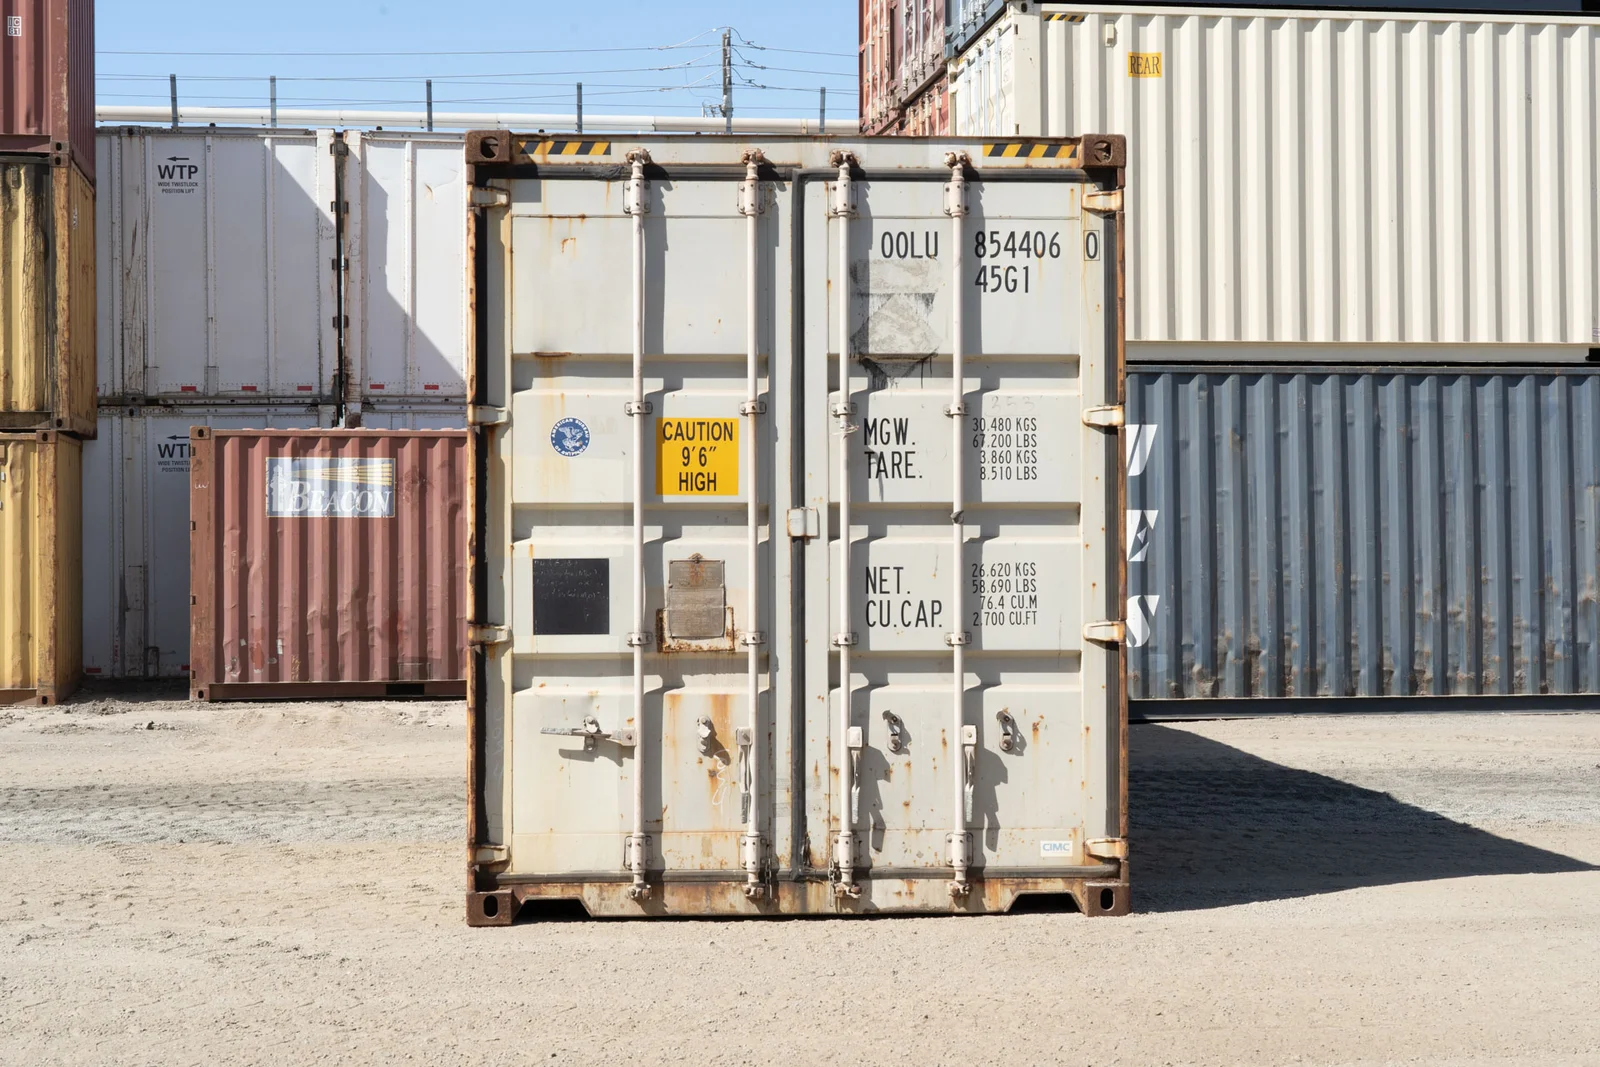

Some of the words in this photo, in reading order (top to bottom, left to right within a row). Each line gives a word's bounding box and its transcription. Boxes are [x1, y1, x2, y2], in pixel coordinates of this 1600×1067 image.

[1129, 56, 1160, 75] REAR
[157, 164, 199, 180] WTP
[881, 231, 939, 260] OOLU
[974, 230, 1061, 259] 854406
[974, 265, 1030, 294] 45G1
[551, 418, 574, 438] AMERICAN
[575, 419, 590, 438] BUREAU
[662, 421, 734, 442] CAUTION
[863, 418, 916, 446] MGW.
[972, 417, 1012, 432] 30.480
[1016, 417, 1037, 432] KGS
[972, 433, 1012, 448] 67.200
[1016, 433, 1037, 448] LBS
[157, 443, 190, 459] WT
[979, 450, 1012, 464] 3.860
[1016, 450, 1038, 464] KGS
[864, 451, 923, 479] TARE.
[678, 471, 718, 492] HIGH
[979, 466, 1012, 481] 8.510
[1016, 466, 1038, 480] LBS
[285, 480, 393, 514] BEACON
[971, 562, 1011, 578] 26.620
[1015, 562, 1037, 576] KGS
[865, 566, 911, 595] NET.
[972, 578, 1012, 594] 58.690
[1015, 578, 1037, 593] LBS
[979, 594, 1005, 610] 76.4
[1010, 594, 1038, 609] CU.M
[972, 611, 1005, 626] 2.700
[1009, 610, 1038, 626] CU.FT
[1042, 842, 1070, 852] CIMC
